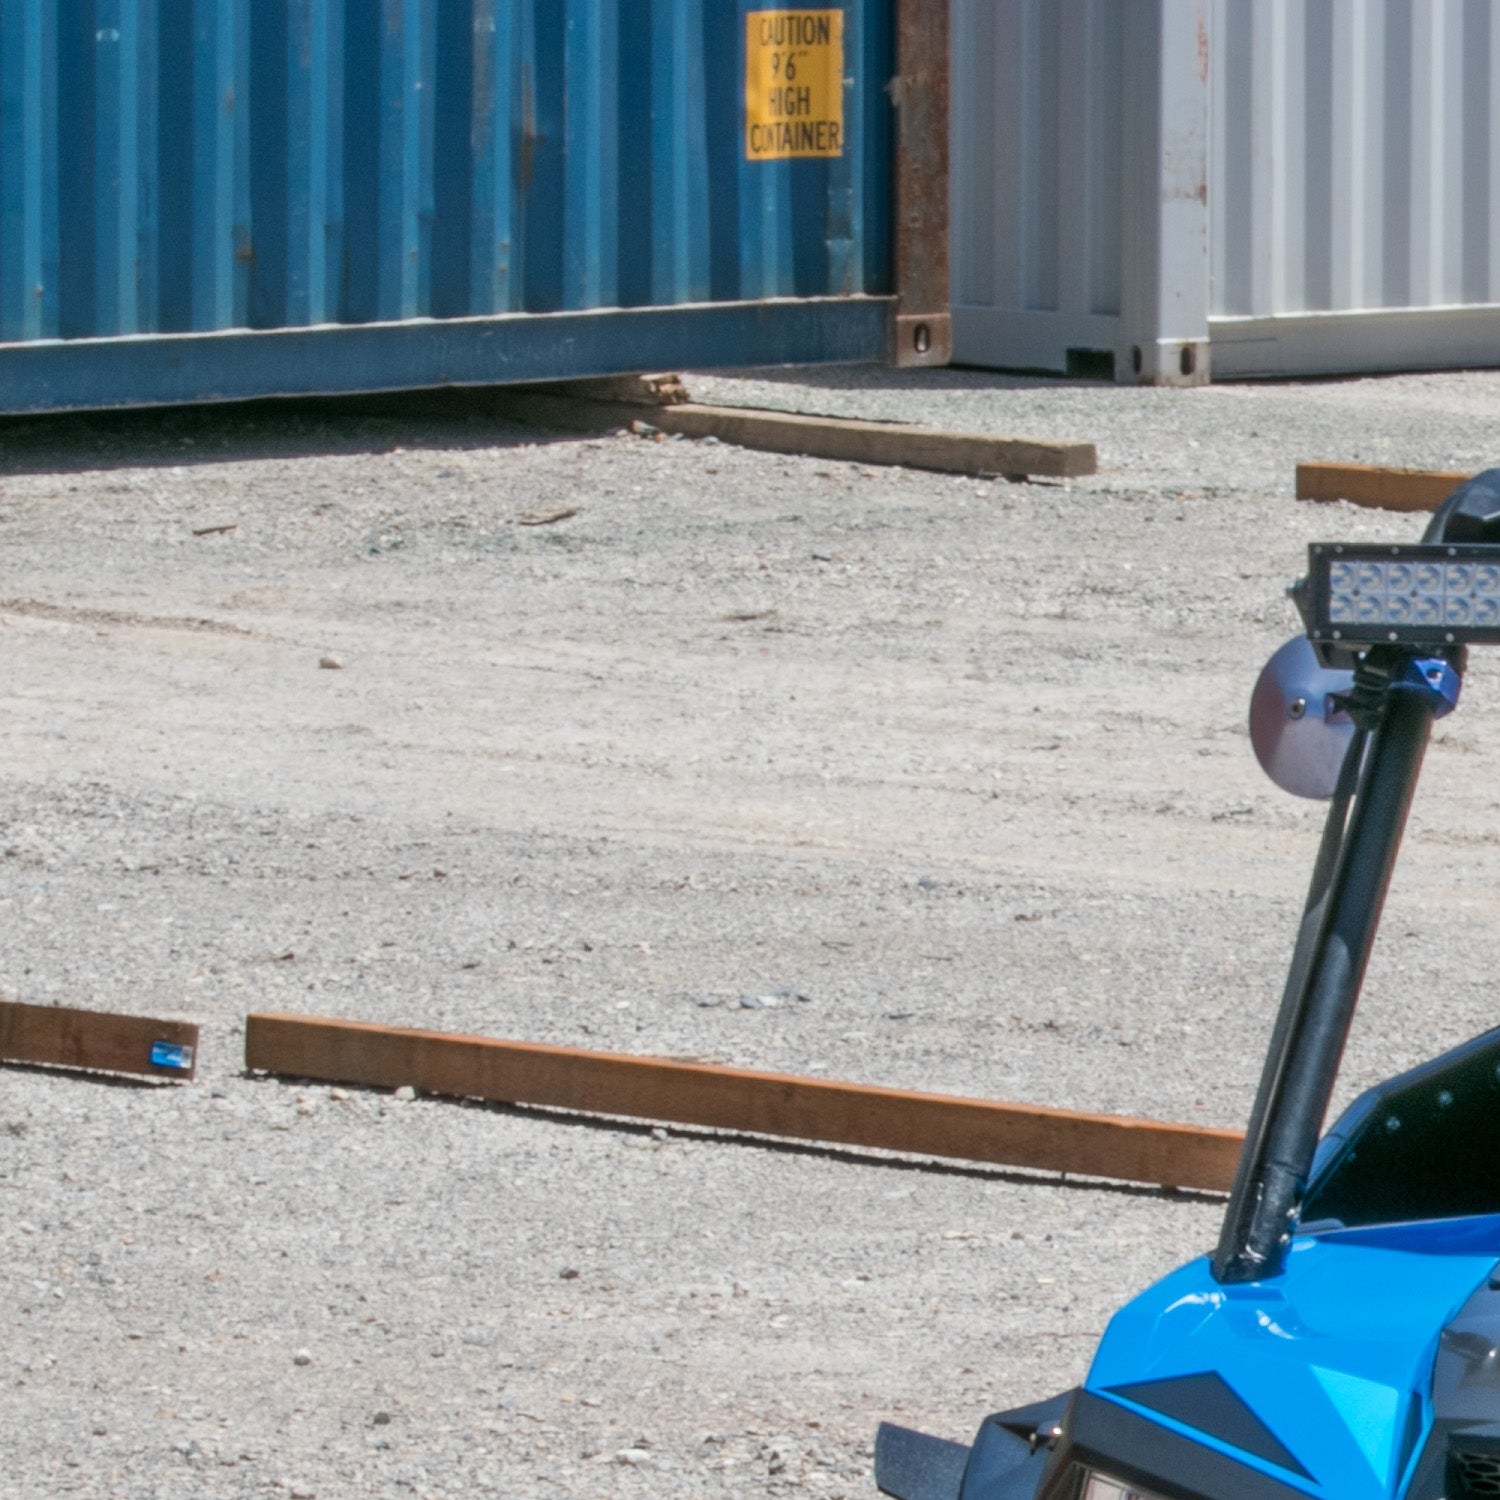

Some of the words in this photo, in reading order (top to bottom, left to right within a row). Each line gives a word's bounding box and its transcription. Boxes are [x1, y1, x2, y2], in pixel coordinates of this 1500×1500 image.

[760, 15, 831, 46] CAUTION
[769, 86, 811, 116] HIGH
[750, 121, 840, 153] CONTAINER
